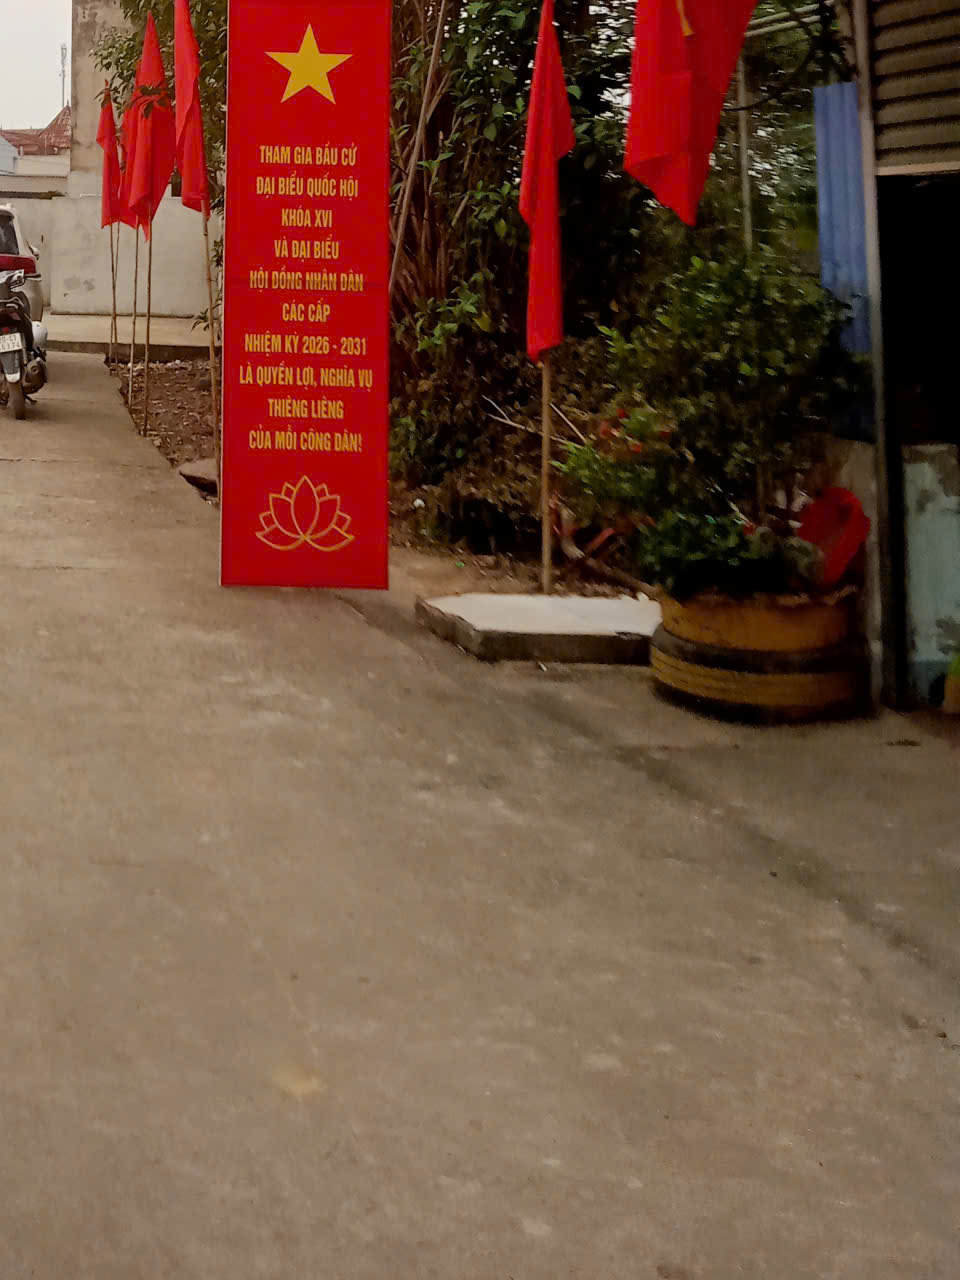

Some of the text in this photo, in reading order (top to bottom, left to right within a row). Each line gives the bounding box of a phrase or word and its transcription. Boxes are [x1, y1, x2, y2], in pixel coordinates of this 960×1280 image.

[260, 146, 290, 163] THAM
[294, 147, 312, 164] GIA
[342, 142, 357, 166] CỬ
[257, 171, 358, 200] ĐẠI BIỂU QUỐC HỘI
[281, 205, 332, 227] KHÓA XVI
[274, 234, 339, 261] VÀ ĐẠI BIỂU
[250, 268, 268, 291] HỘI
[306, 269, 336, 290] NHÂN
[341, 270, 363, 291] DÂN
[282, 298, 331, 322] CÁC CẤP
[245, 331, 281, 356] NHIỆM
[303, 336, 329, 354] 2026
[341, 337, 365, 355] 2031
[240, 362, 253, 384] LÀ
[297, 367, 316, 389] LỢI,
[359, 370, 372, 391] VỤ
[250, 425, 271, 448] CỦA
[301, 429, 330, 450] CÔNG
[335, 430, 361, 451] DÂN!
